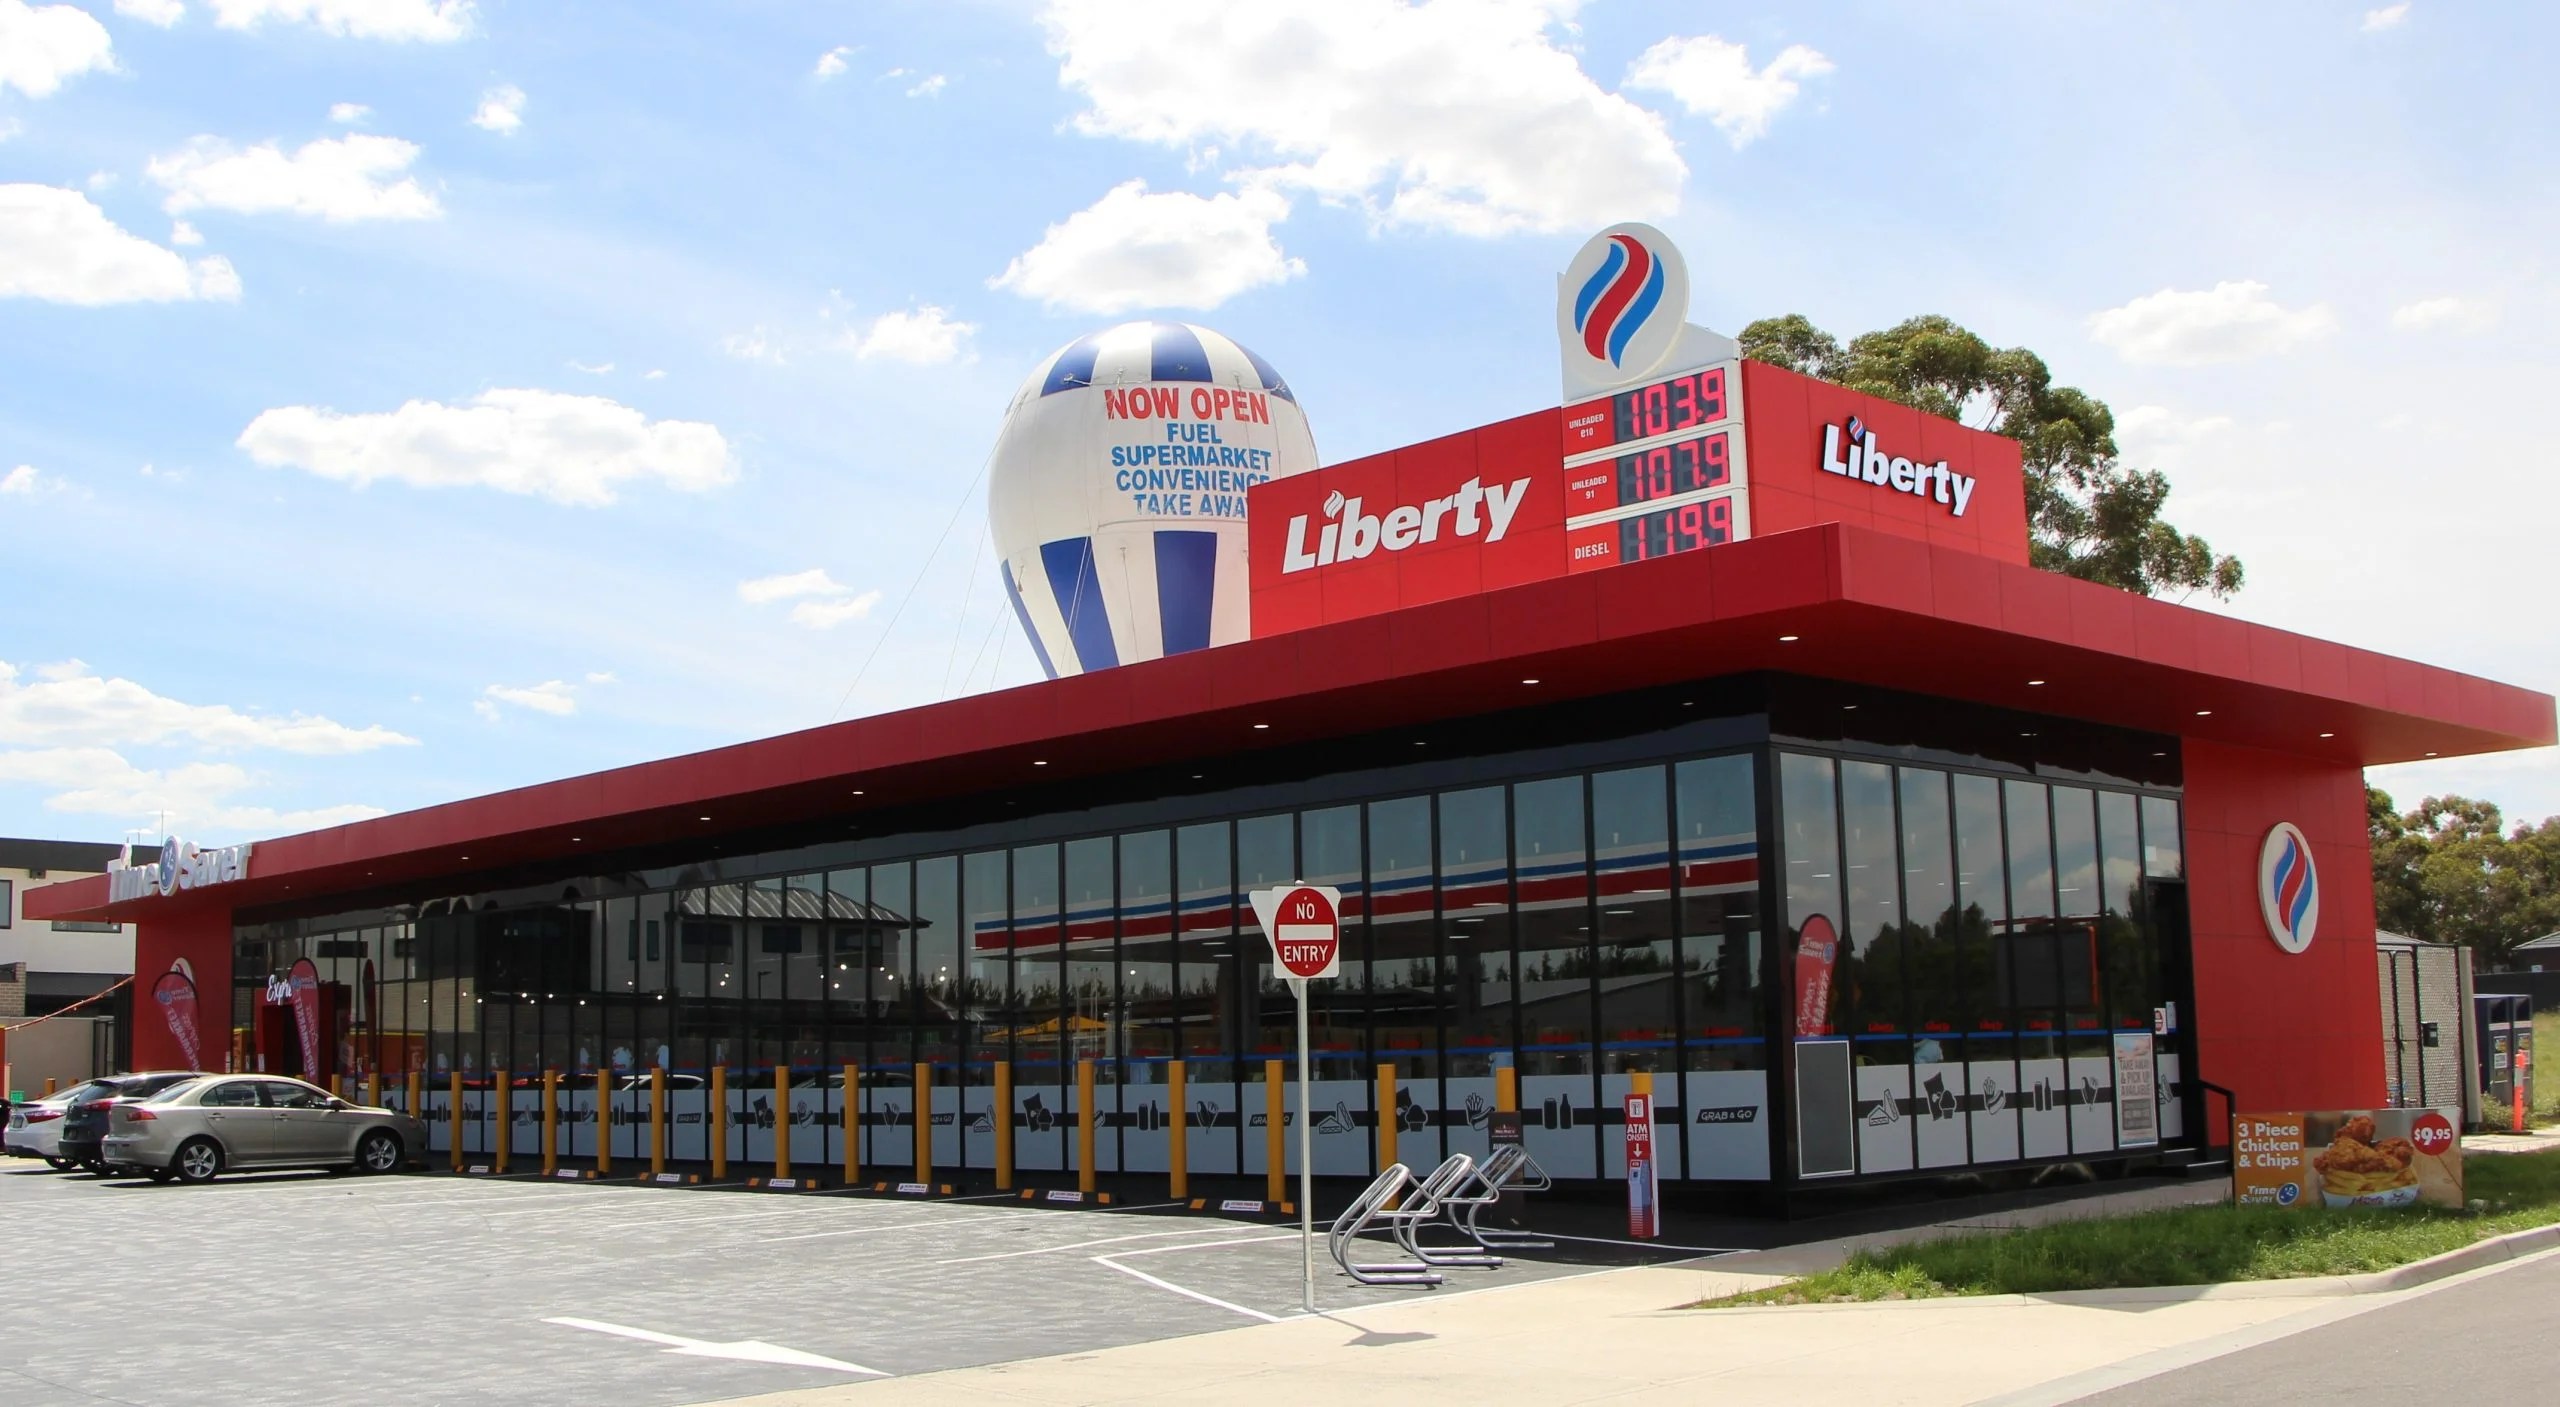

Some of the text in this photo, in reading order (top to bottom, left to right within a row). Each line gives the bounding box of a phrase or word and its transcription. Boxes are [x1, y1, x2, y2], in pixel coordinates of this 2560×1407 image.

[1104, 387, 1269, 425] NOW OPEN
[1631, 368, 1728, 437] 103.9
[1569, 413, 1604, 430] UNLEADED
[1166, 423, 1222, 443] FUEL
[1580, 427, 1594, 438] e10
[1111, 445, 1272, 471] SUPERMARKET
[1635, 433, 1731, 500] 107.9
[1823, 416, 1976, 517] Liberty
[1571, 475, 1607, 491] UNLEADED
[1585, 490, 1595, 499] 91
[1133, 494, 1248, 518] TAKE AWA
[1282, 476, 1532, 575] Liberty
[1638, 497, 1734, 561] 119.9
[1574, 542, 1610, 560] DIESEL
[180, 841, 252, 890] Saver
[1296, 903, 1315, 919] NO
[1283, 945, 1328, 962] ENTRY
[1252, 1116, 1268, 1125] GRA
[1701, 1111, 1728, 1120] GRAB
[1737, 1110, 1752, 1119] GO
[1627, 1123, 1648, 1134] ATM
[2238, 1121, 2299, 1138] 3 Piece
[2414, 1127, 2451, 1146] $9.95
[1627, 1133, 1649, 1142] ONSITE
[2238, 1138, 2299, 1152] Chicken
[2239, 1152, 2300, 1170] & Chips
[2247, 1184, 2277, 1195] Time
